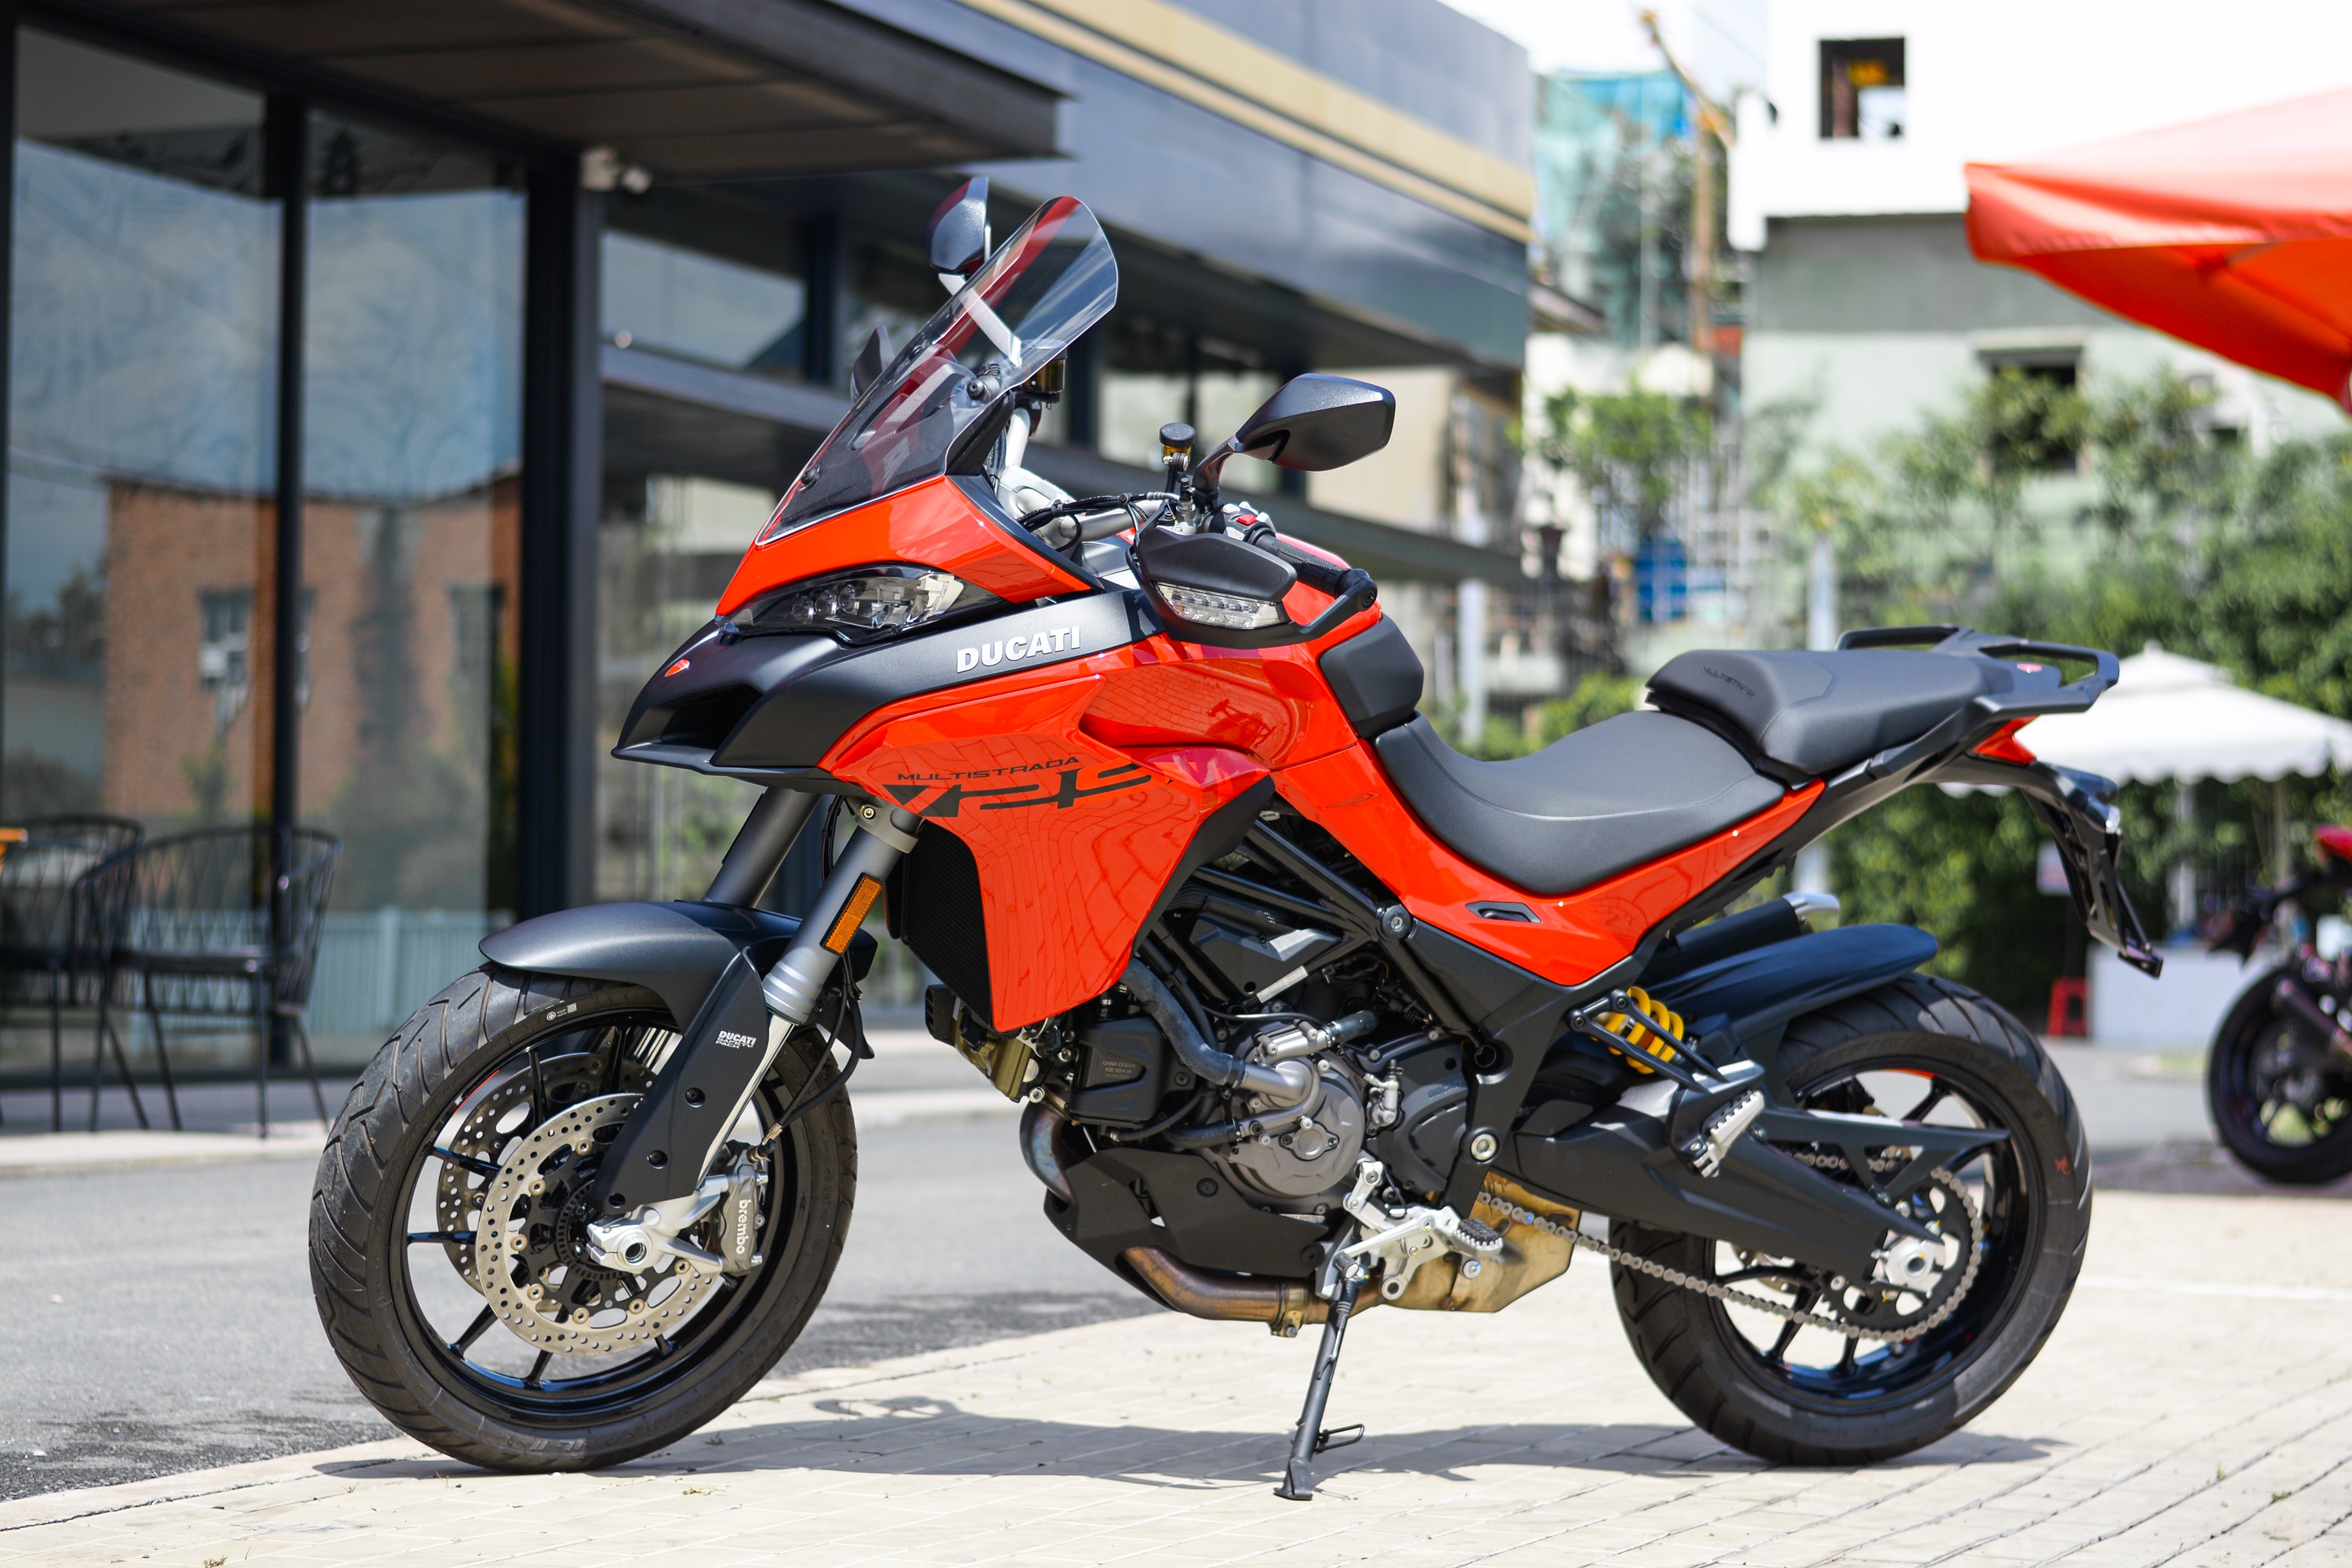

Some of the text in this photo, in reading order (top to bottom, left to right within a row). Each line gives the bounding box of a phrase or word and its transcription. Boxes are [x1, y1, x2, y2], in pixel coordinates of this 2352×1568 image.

[956, 626, 1081, 673] DUCATI
[897, 756, 1080, 781] MULTISTRADA
[715, 1040, 740, 1049] PACK
[717, 1037, 754, 1048] SAFETY
[718, 1030, 757, 1045] DUCATI
[735, 1199, 752, 1255] brembo
